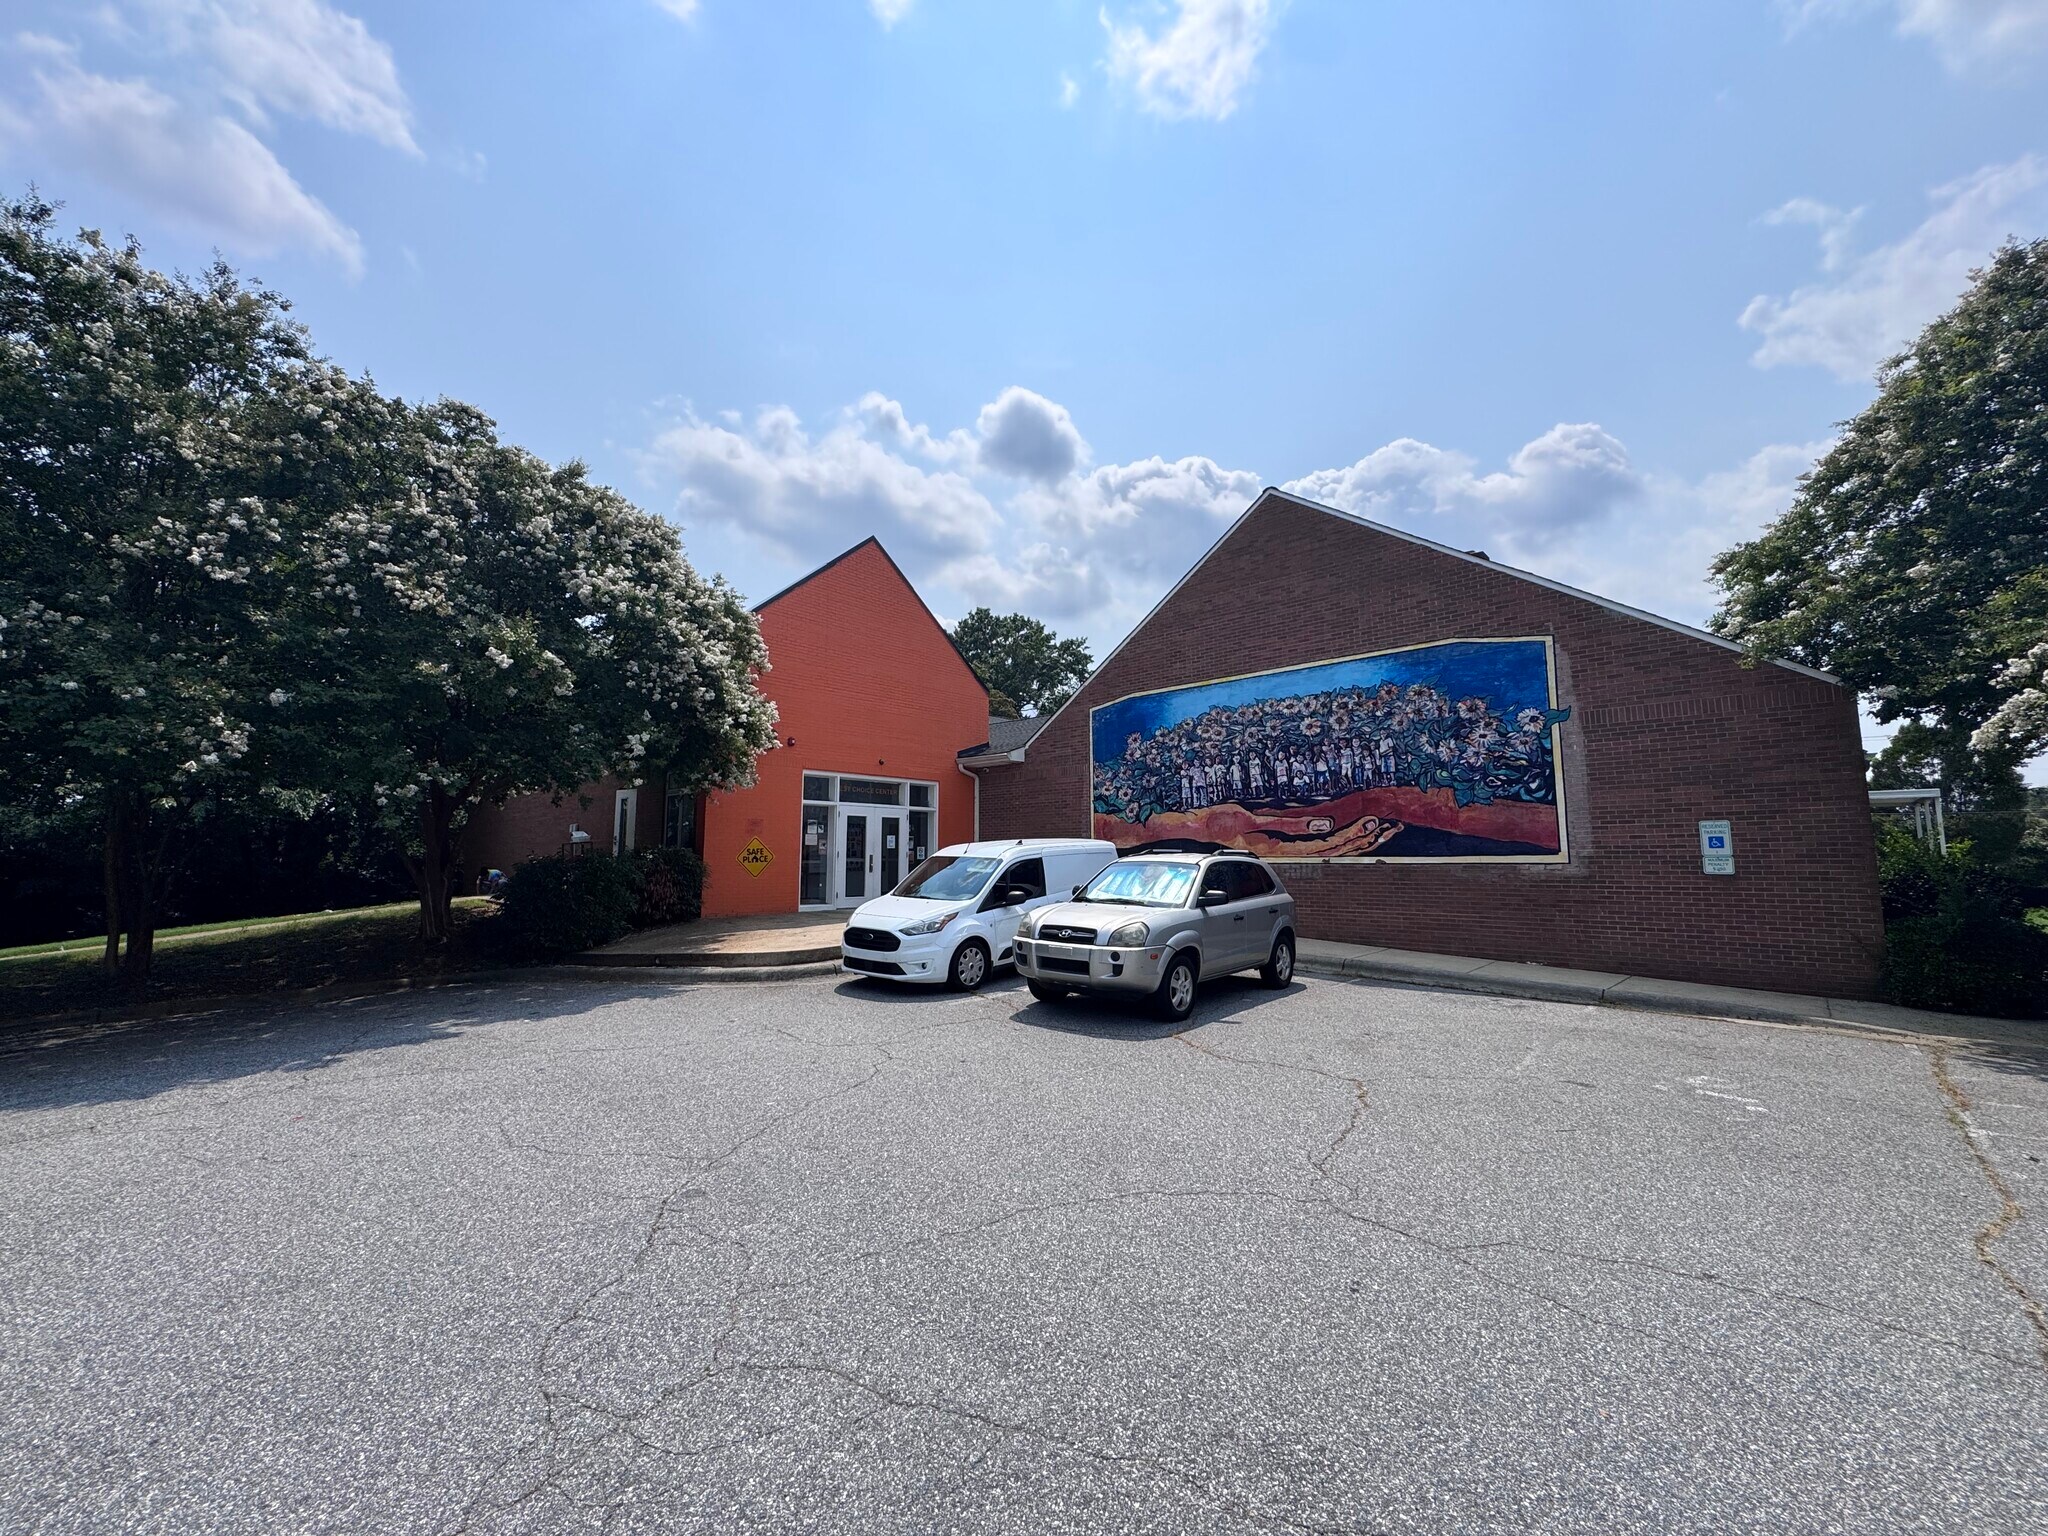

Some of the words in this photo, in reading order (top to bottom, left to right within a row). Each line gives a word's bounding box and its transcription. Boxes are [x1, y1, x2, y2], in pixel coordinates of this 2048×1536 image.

[852, 786, 874, 794] CHOICE
[875, 788, 897, 796] CENTER
[746, 848, 764, 856] SAFE
